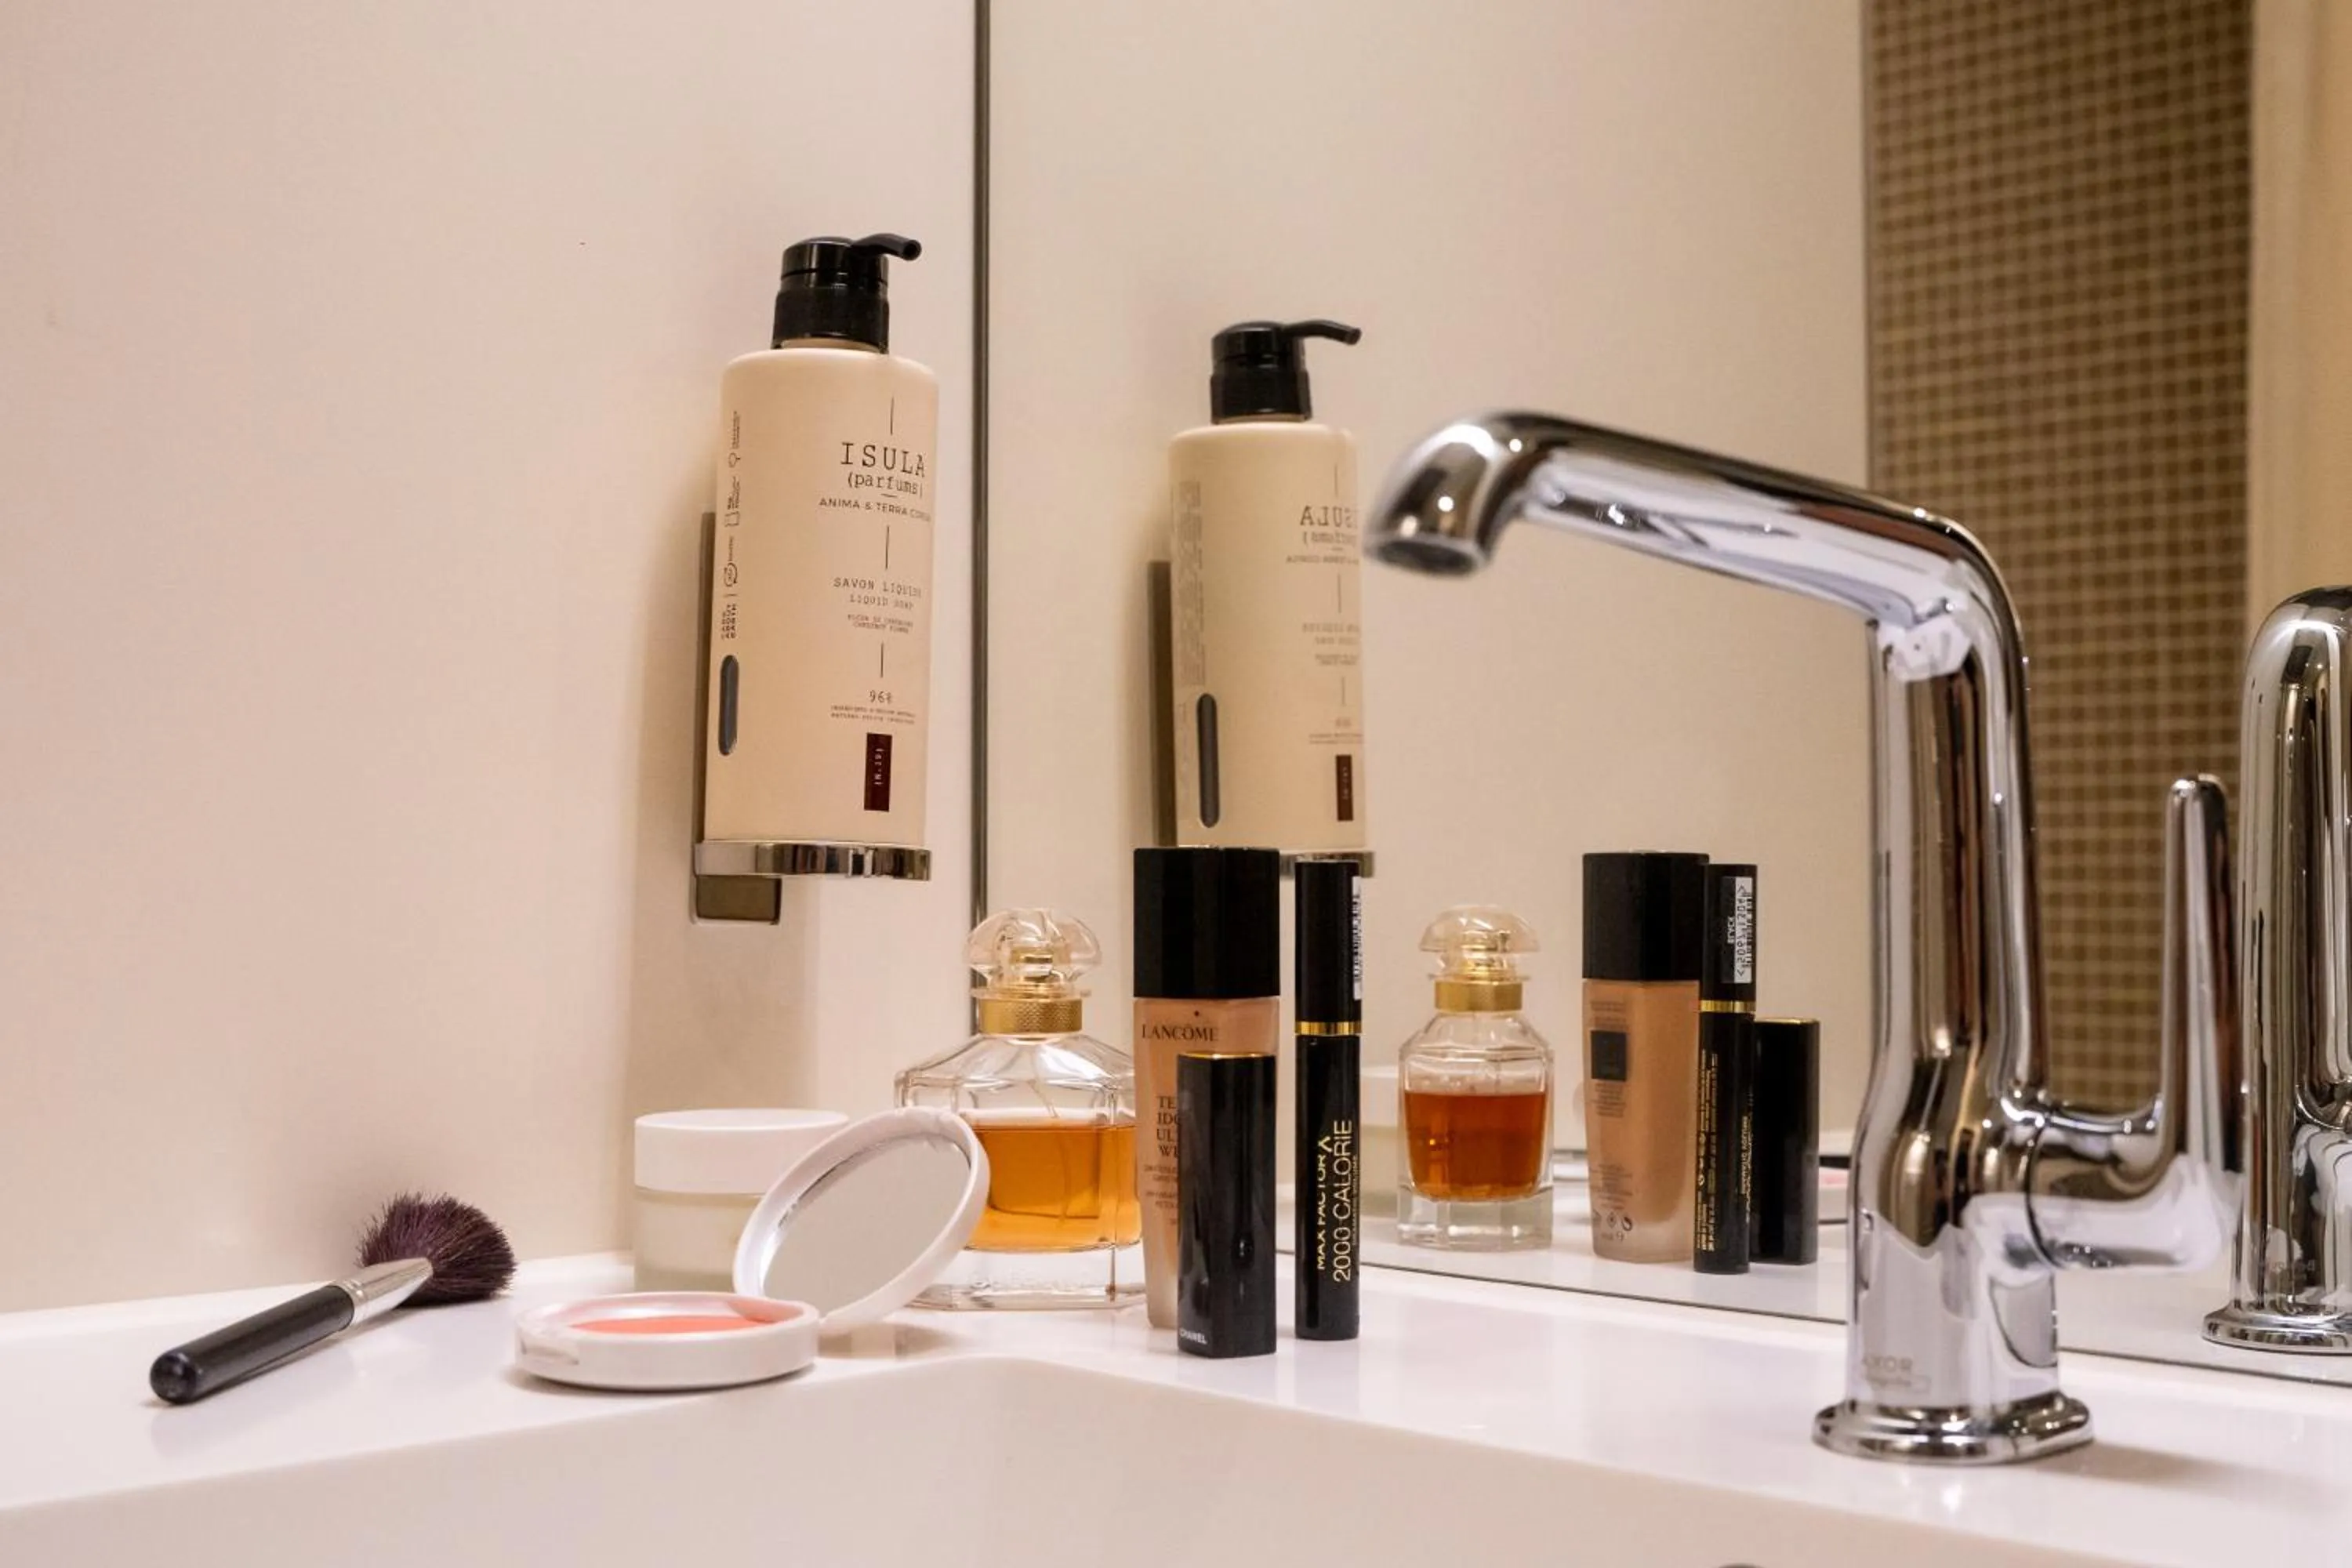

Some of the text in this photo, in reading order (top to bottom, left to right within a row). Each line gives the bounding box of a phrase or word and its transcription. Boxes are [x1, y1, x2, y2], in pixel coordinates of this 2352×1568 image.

[841, 442, 924, 477] ISULA
[848, 471, 923, 499] (parfums)
[819, 497, 860, 510] ANIMA
[865, 501, 872, 510] &
[877, 503, 908, 515] TERRA
[833, 577, 874, 590] SAVON
[850, 593, 888, 607] LIQUID
[1142, 1023, 1218, 1042] LANCÔME
[1156, 1095, 1177, 1109] TE
[1156, 1128, 1176, 1142] UL
[1333, 1120, 1352, 1283] 2000 CALORIE
[1317, 1229, 1326, 1270] MAX
